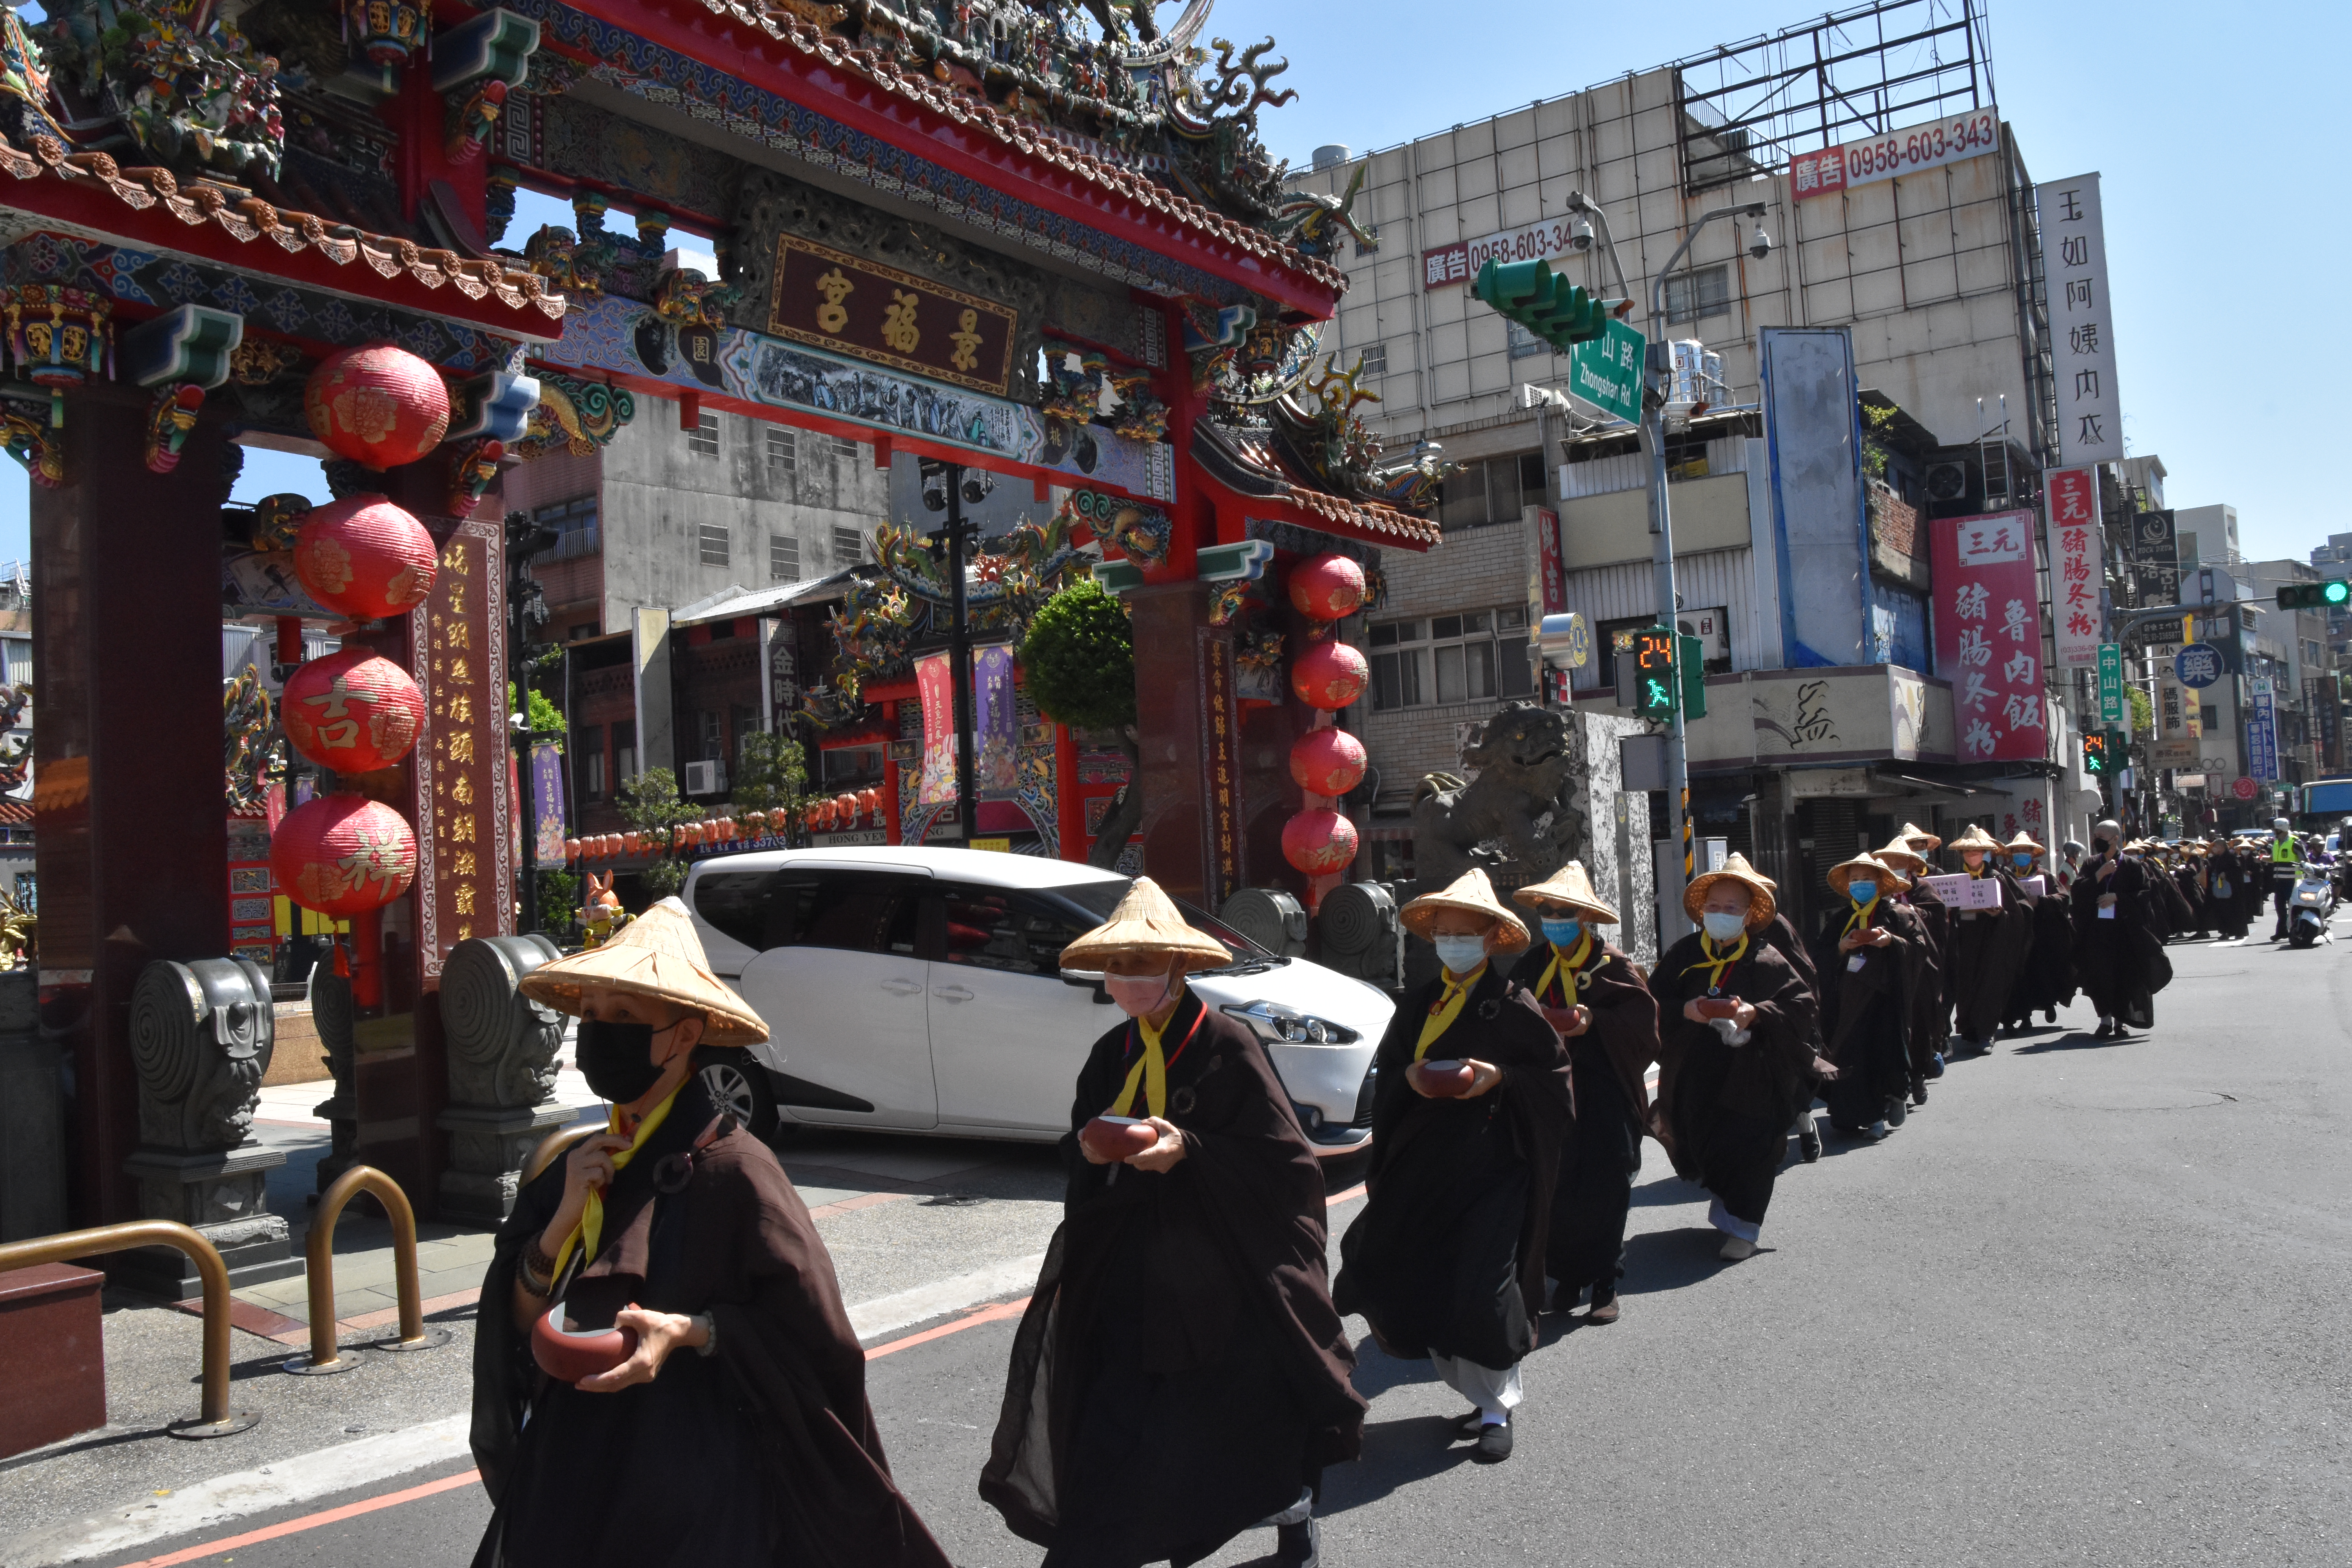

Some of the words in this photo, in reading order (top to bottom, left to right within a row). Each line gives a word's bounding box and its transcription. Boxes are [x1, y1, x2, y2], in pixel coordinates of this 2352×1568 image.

[1796, 154, 1842, 191] 廣告
[1849, 115, 1993, 178] 0958-603-343
[1426, 249, 1467, 285] 廣告
[1471, 222, 1573, 272] 0958-603-34
[1581, 362, 1619, 401] Zhongshan
[1621, 384, 1631, 407] Rd.
[2060, 477, 2087, 521] 三元
[1966, 528, 2019, 555] 三元
[2061, 528, 2097, 636] 豬腸冬粉
[1640, 637, 1671, 668] 24
[1955, 582, 2002, 756] 豬腸冬粉
[1999, 599, 2043, 731] 魯肉飯
[2060, 645, 2097, 654] (03)336-06
[2182, 650, 2216, 682] 藥
[2103, 656, 2118, 709] 中山路
[302, 673, 380, 751] 吉
[2085, 735, 2102, 751] 24
[829, 834, 859, 844] HONG
[927, 828, 944, 836] NG
[1316, 832, 1352, 871] 祥
[337, 826, 408, 902] 祥
